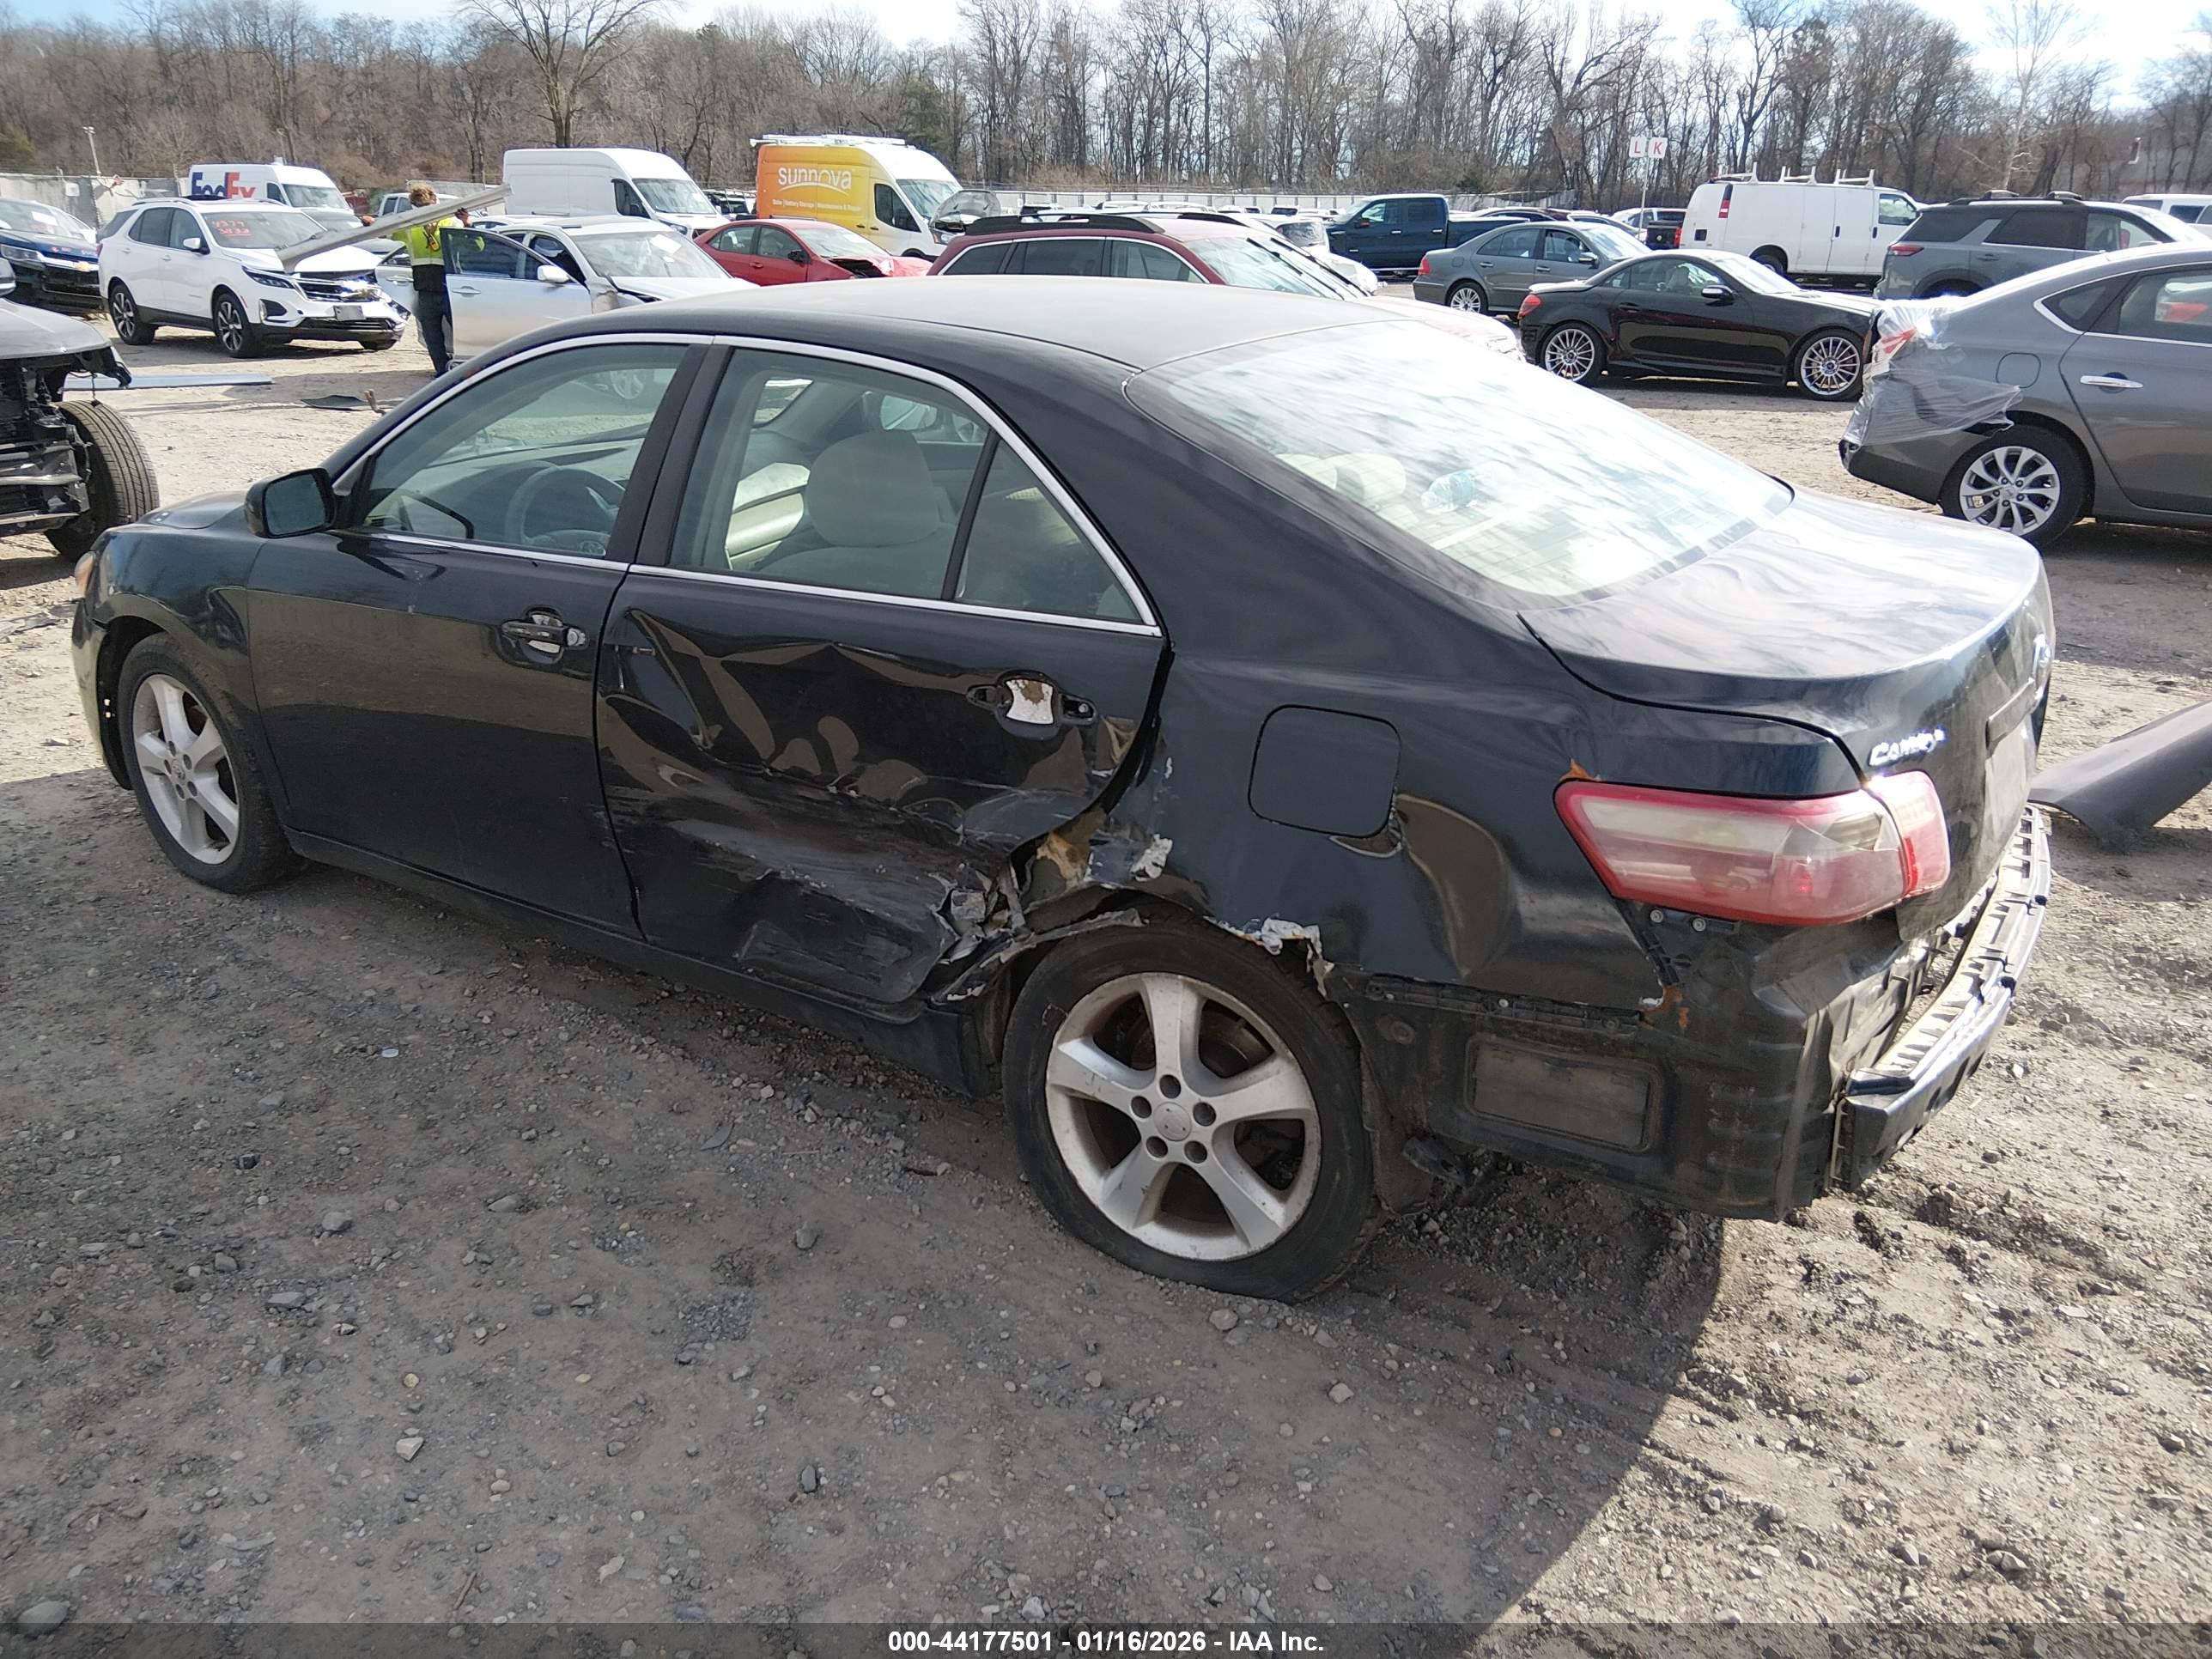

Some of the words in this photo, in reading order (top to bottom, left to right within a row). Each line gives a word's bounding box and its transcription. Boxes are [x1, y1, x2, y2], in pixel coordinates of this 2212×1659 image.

[1634, 141, 1641, 154] L
[1653, 141, 1662, 155] K
[777, 167, 852, 190] sunnova
